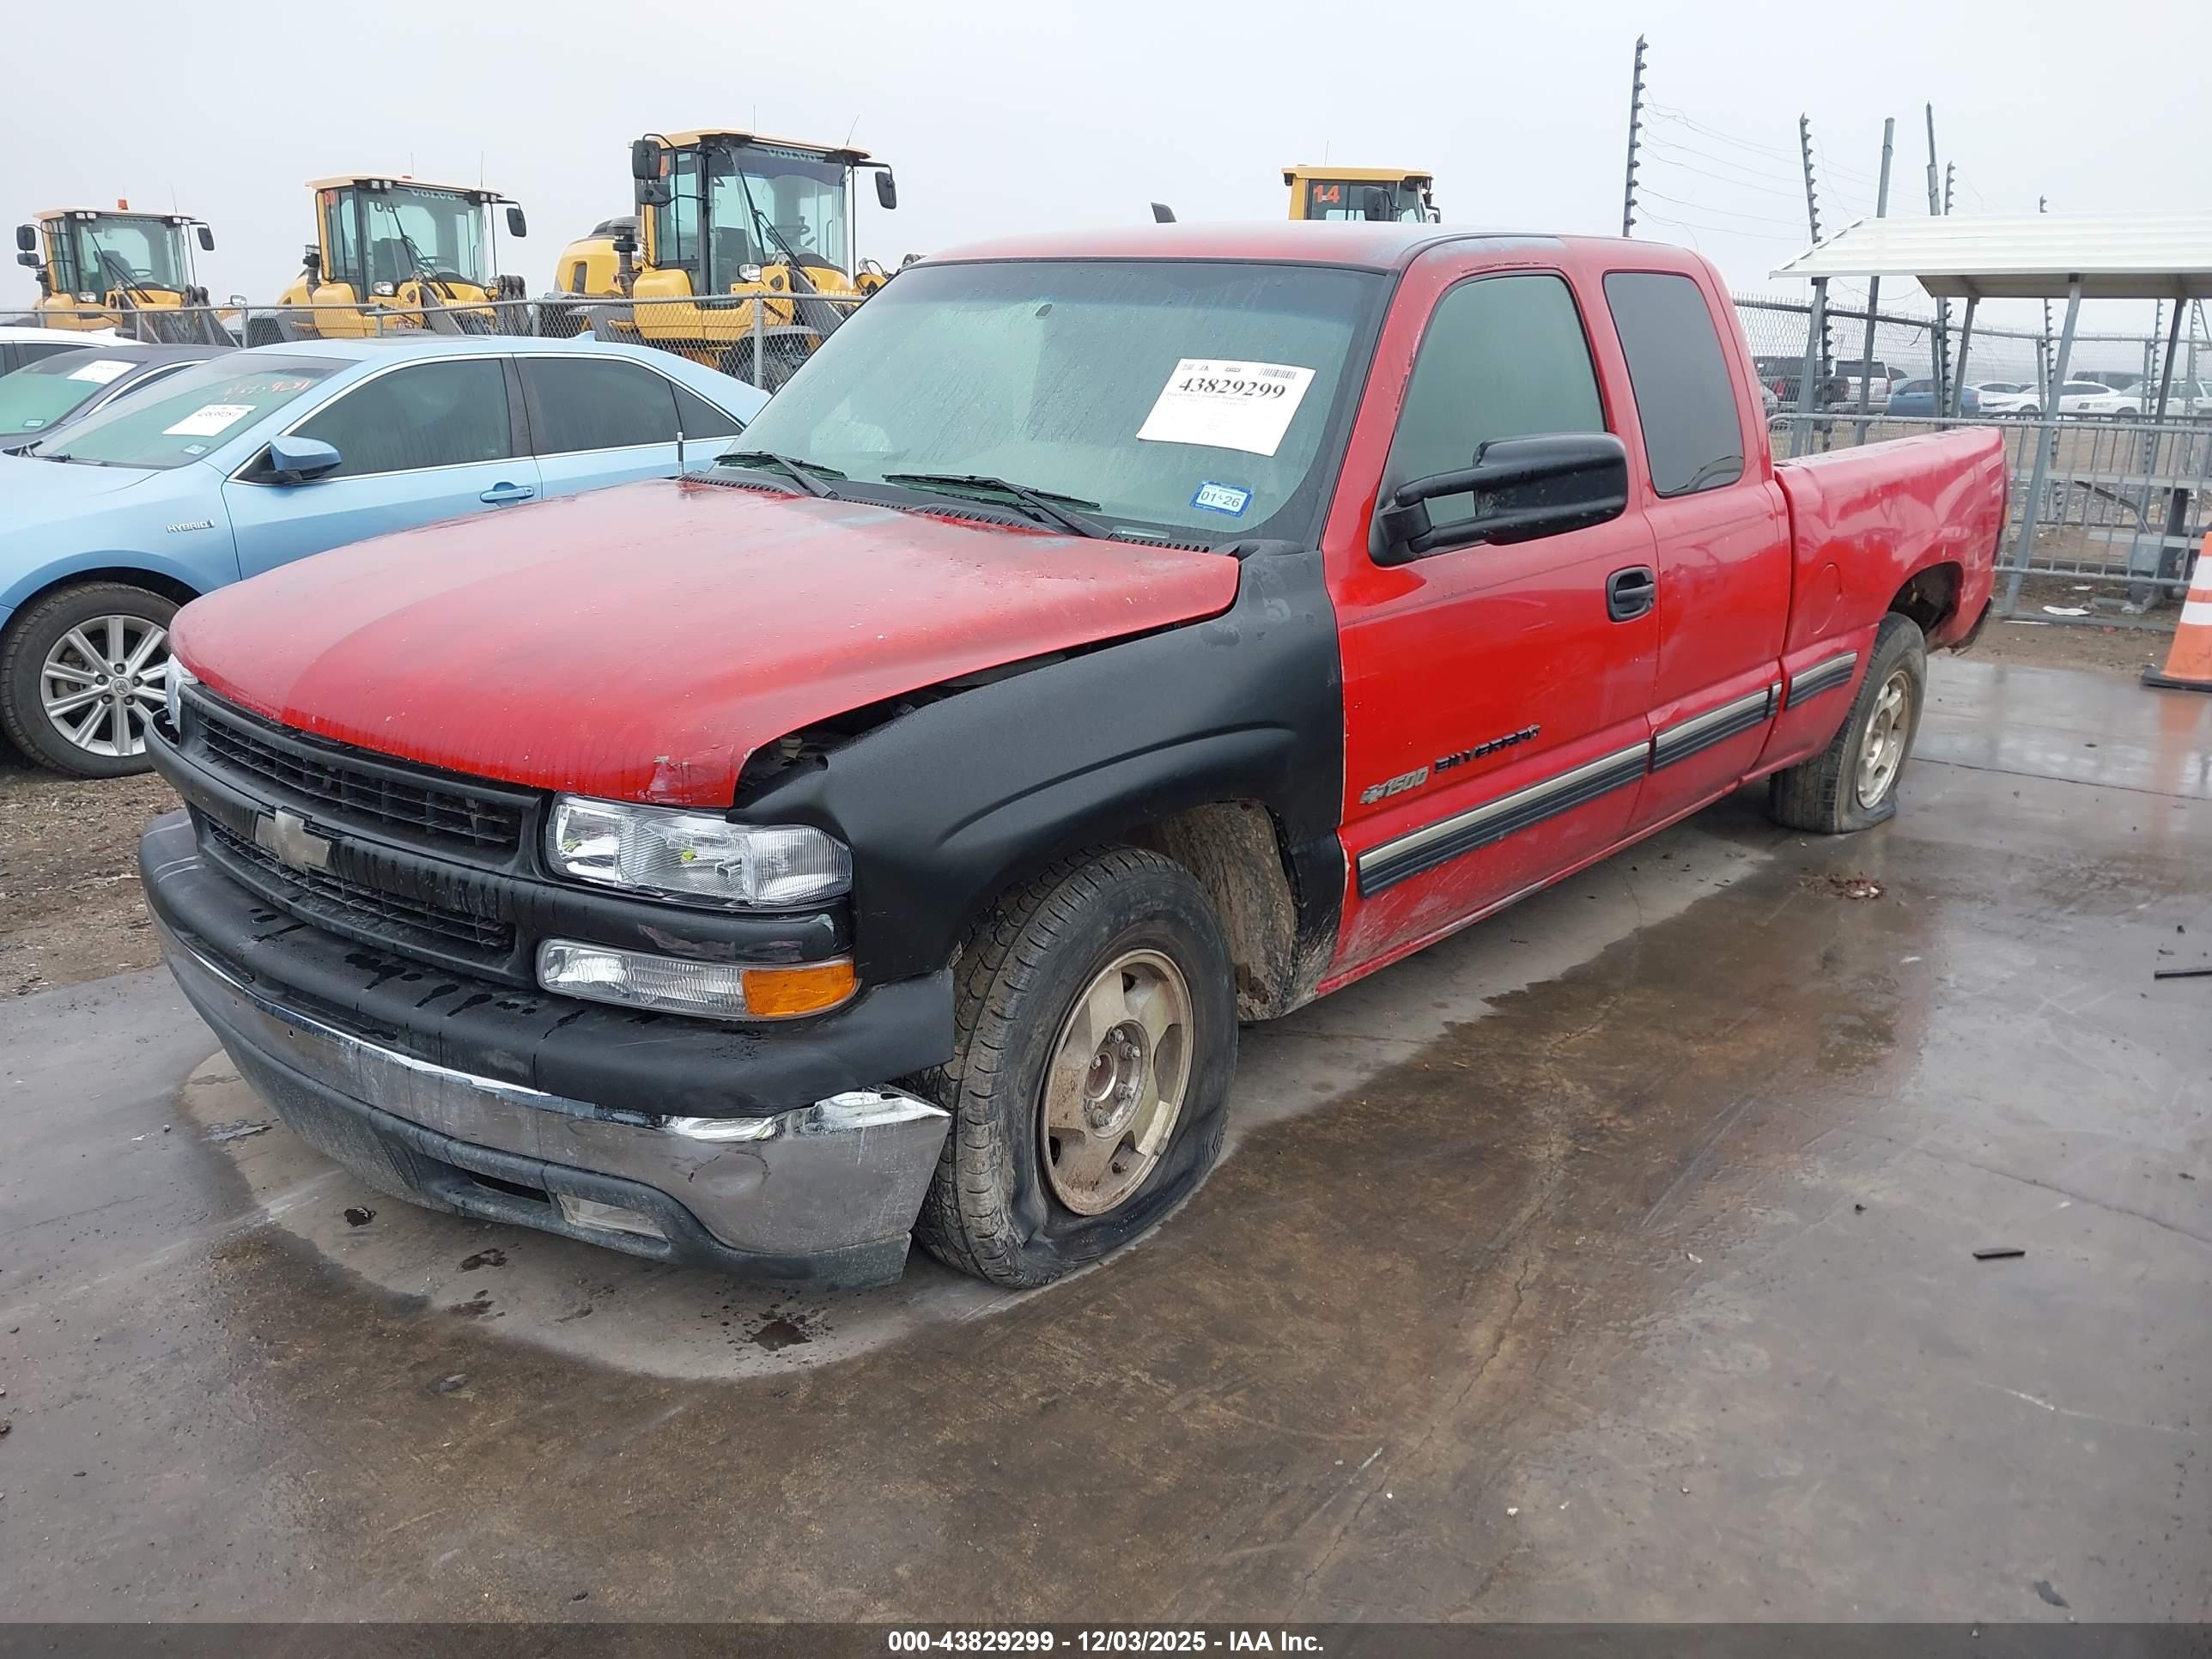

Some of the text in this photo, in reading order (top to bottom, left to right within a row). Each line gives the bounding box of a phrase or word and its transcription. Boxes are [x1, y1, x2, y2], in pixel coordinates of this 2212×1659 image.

[768, 149, 818, 162] VOLVO
[411, 190, 457, 201] VOLVO
[1313, 185, 1340, 204] 14
[1179, 377, 1286, 399] 43829299
[1200, 490, 1217, 502] 01
[1223, 495, 1242, 507] 26
[167, 521, 208, 533] HYBRID
[1384, 766, 1429, 796] 1500
